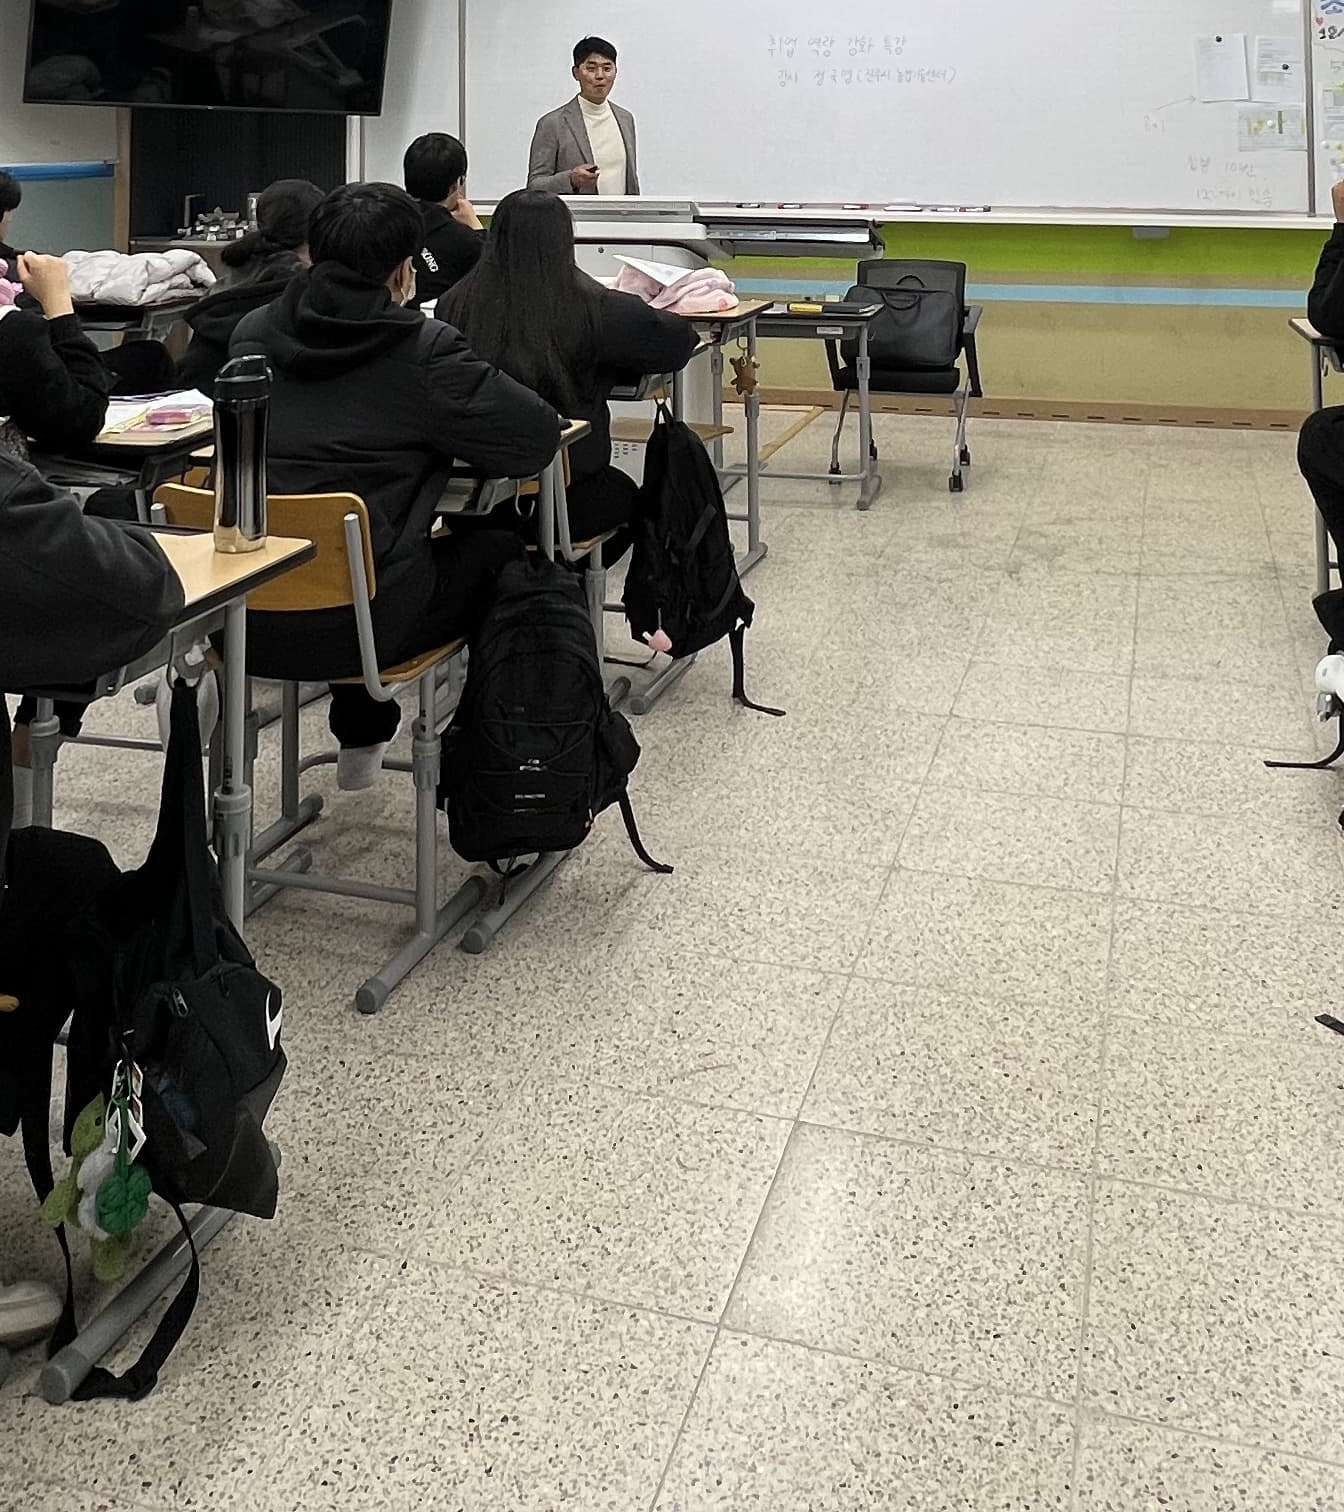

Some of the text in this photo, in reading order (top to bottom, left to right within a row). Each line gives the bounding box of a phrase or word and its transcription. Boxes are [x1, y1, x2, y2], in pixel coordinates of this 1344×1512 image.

[767, 34, 907, 59] 취업 역량 강화 특강
